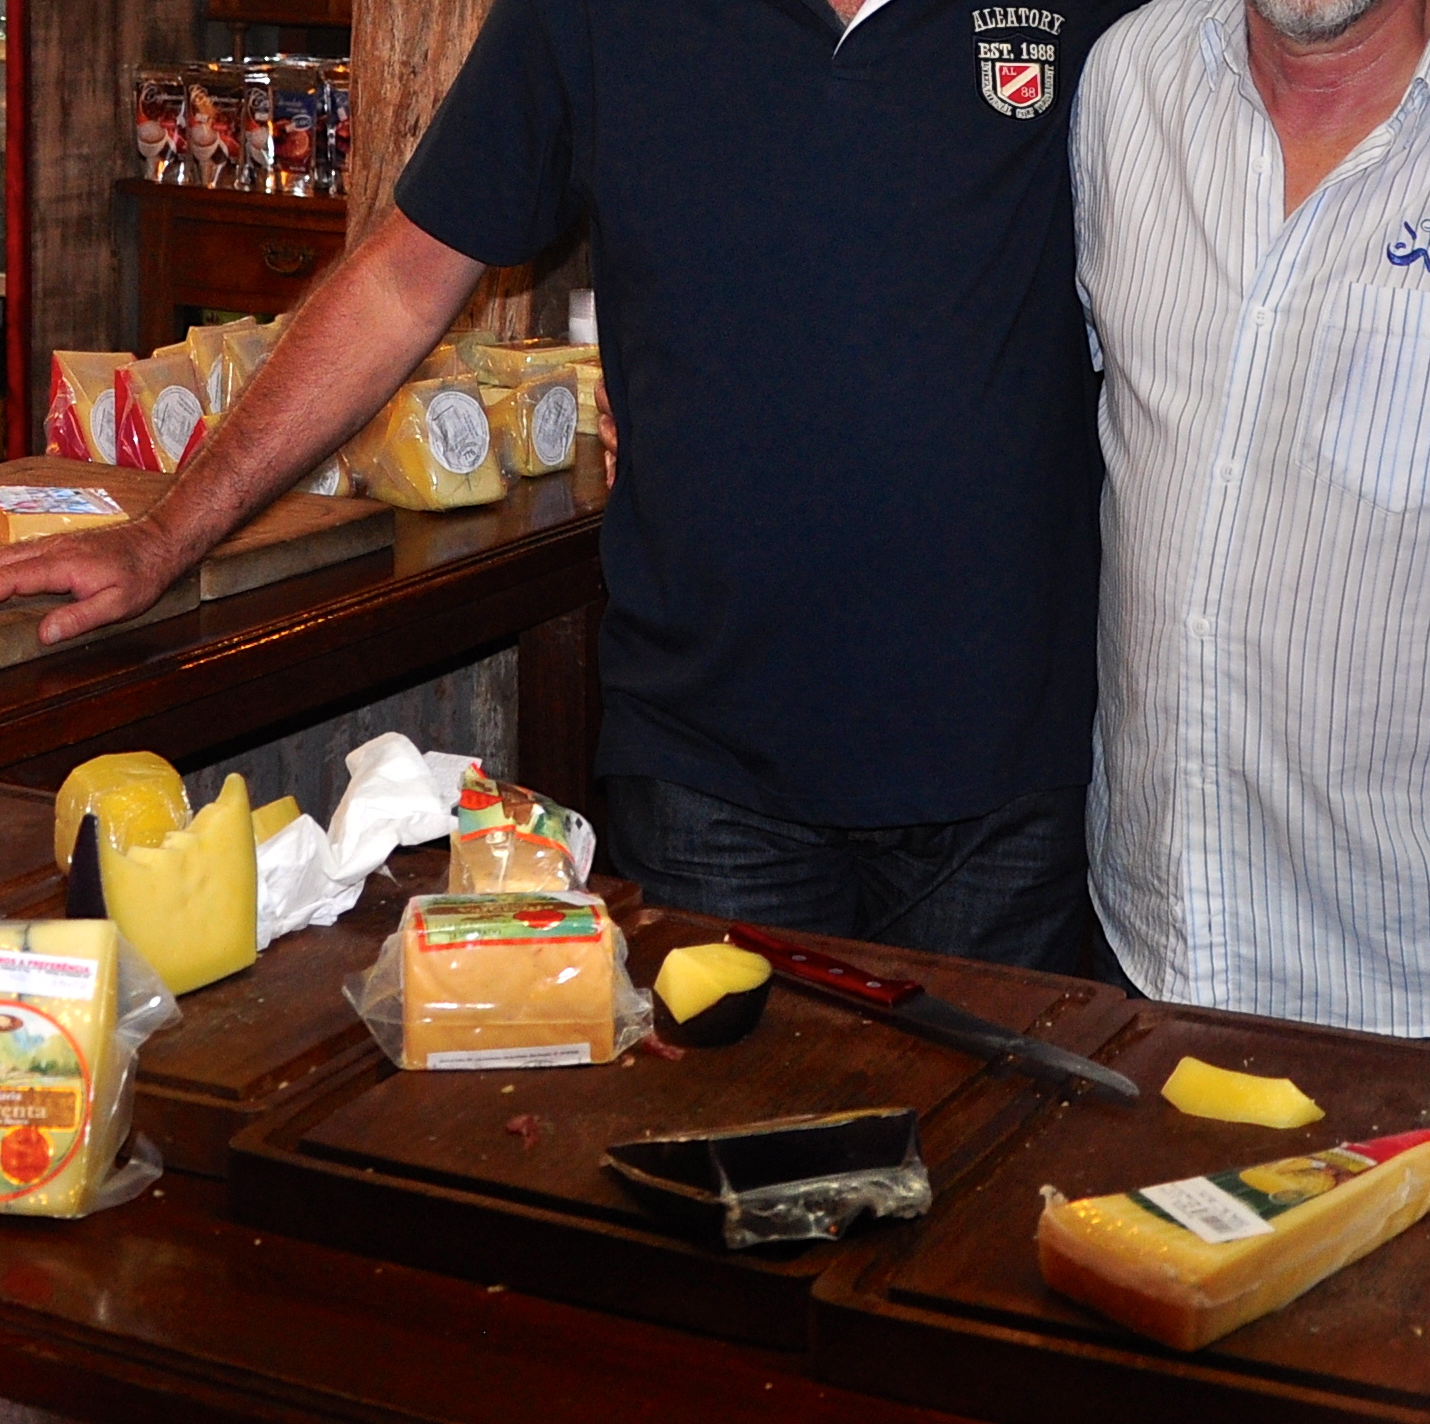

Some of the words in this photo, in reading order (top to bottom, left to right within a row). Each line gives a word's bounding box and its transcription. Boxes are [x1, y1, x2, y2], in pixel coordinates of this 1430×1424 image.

[972, 7, 1065, 36] ALEATORY
[978, 42, 1014, 59] EST.
[1020, 42, 1055, 61] 1988
[1001, 66, 1017, 75] AL
[1020, 86, 1036, 97] 88
